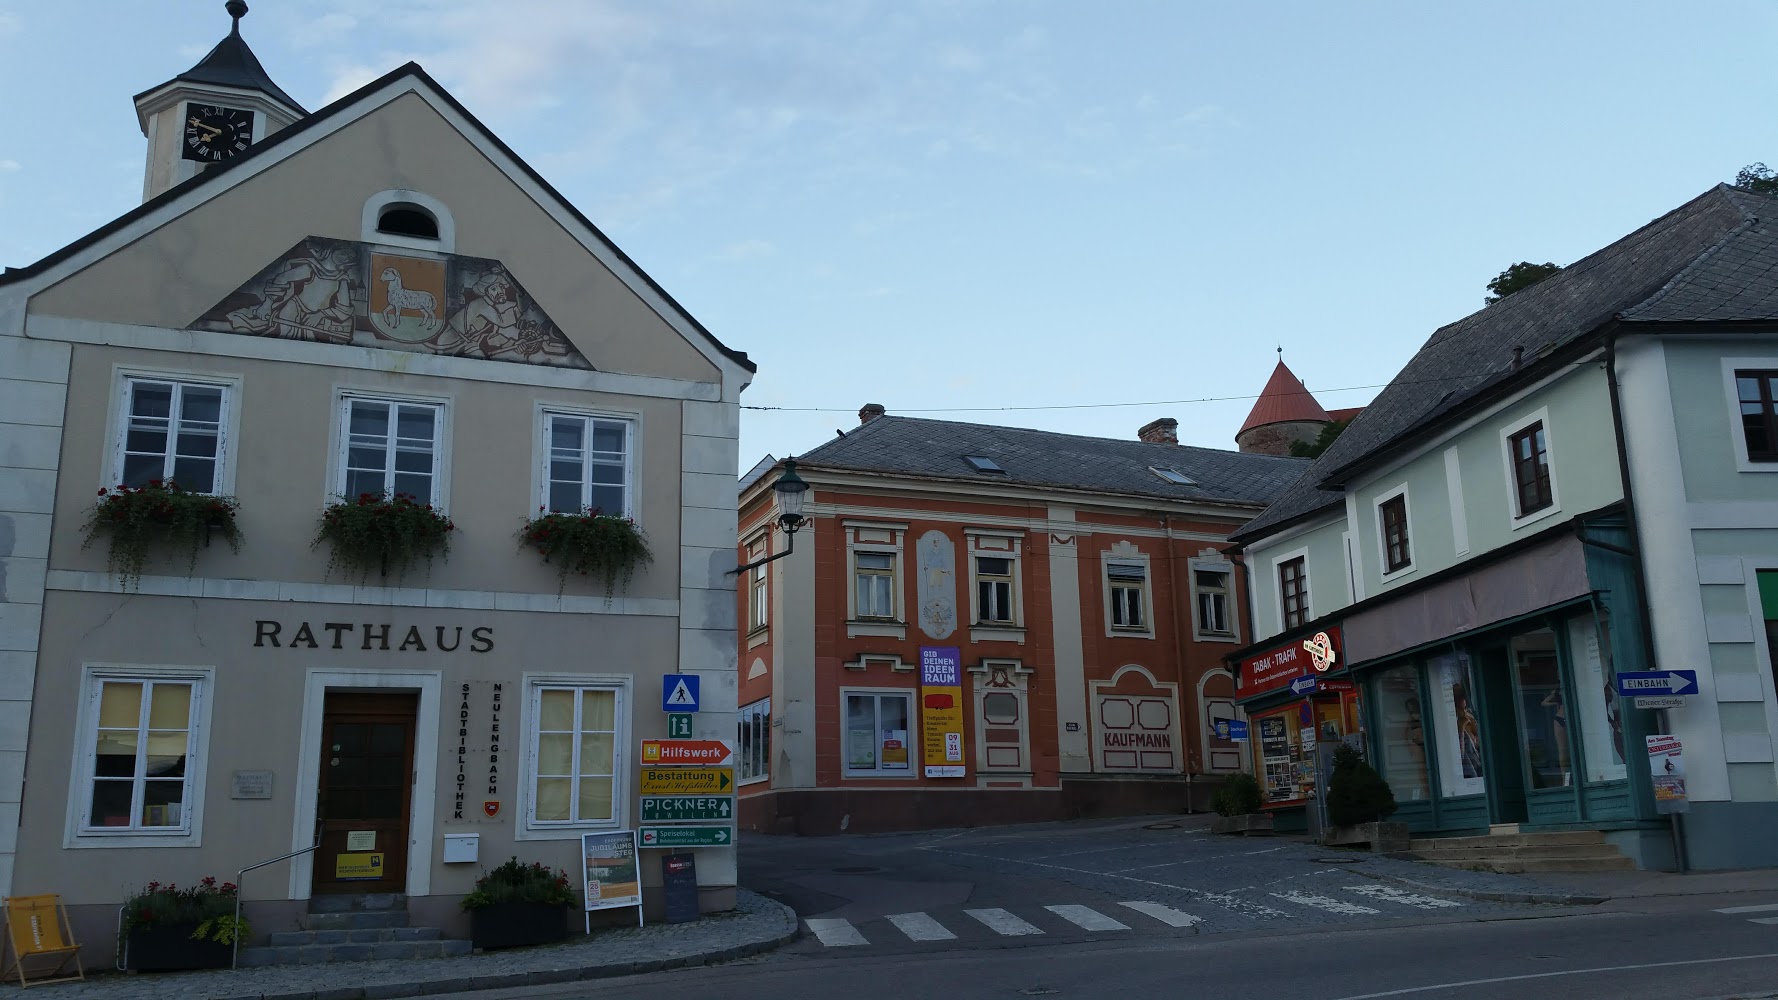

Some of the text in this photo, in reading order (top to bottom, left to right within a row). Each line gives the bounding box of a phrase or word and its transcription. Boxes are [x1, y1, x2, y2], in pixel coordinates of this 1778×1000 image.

[254, 620, 494, 652] RATHAUS
[923, 650, 938, 658] GIB
[1252, 656, 1272, 674] TABAK
[1274, 647, 1297, 666] TRAFIK
[924, 665, 955, 674] IDEEN
[924, 673, 956, 683] RAUM
[1627, 679, 1669, 688] EINBAHN
[488, 683, 501, 794] NEULENGBACH
[1104, 733, 1170, 747] KAUFMANN
[454, 683, 470, 819] STADTBIBLIOTHEK
[661, 747, 720, 757] Hilfswerk
[648, 772, 714, 782] Bestattung
[643, 781, 671, 789] Ernst
[644, 799, 718, 810] PICKNER
[643, 811, 718, 819] JUWELEN
[590, 842, 633, 851] JUBILÄUMS
